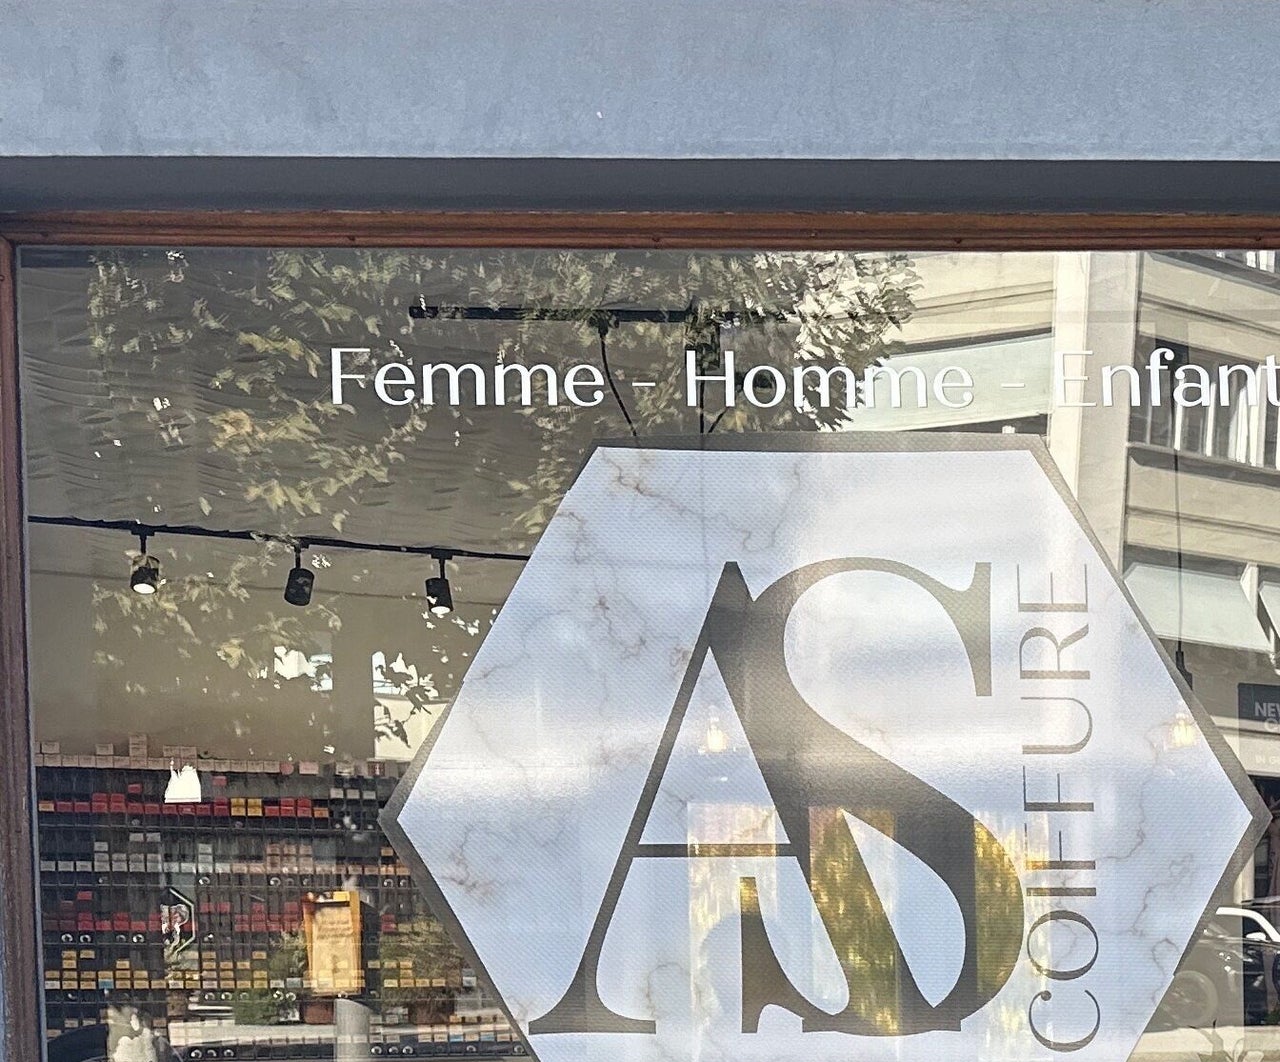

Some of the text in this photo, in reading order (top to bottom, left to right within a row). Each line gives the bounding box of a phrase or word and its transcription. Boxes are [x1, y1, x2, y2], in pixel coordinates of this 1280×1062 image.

[331, 347, 604, 407] Femme
[685, 349, 975, 408] Homme
[528, 557, 1025, 1037] AS
[1017, 563, 1101, 1053] COIFFURE
